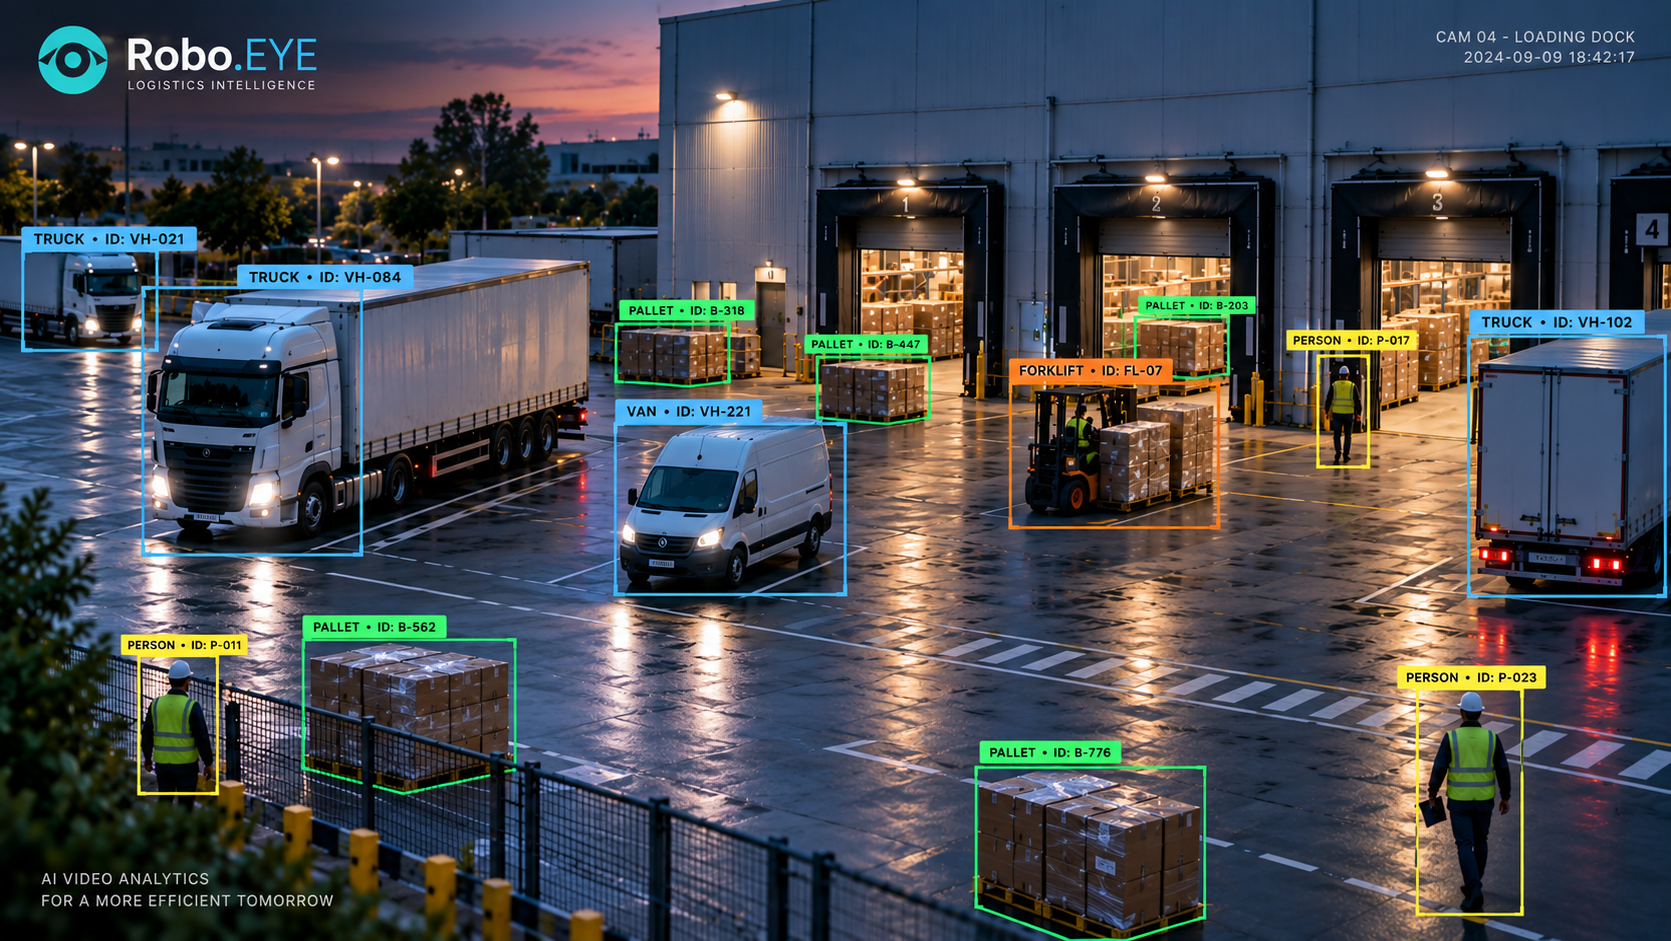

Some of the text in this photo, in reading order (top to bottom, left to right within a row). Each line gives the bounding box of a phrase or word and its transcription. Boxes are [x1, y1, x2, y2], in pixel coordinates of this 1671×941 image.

[902, 196, 909, 213] 1
[1151, 195, 1161, 212] 2
[1432, 193, 1443, 212] 3
[1645, 219, 1660, 239] 4
